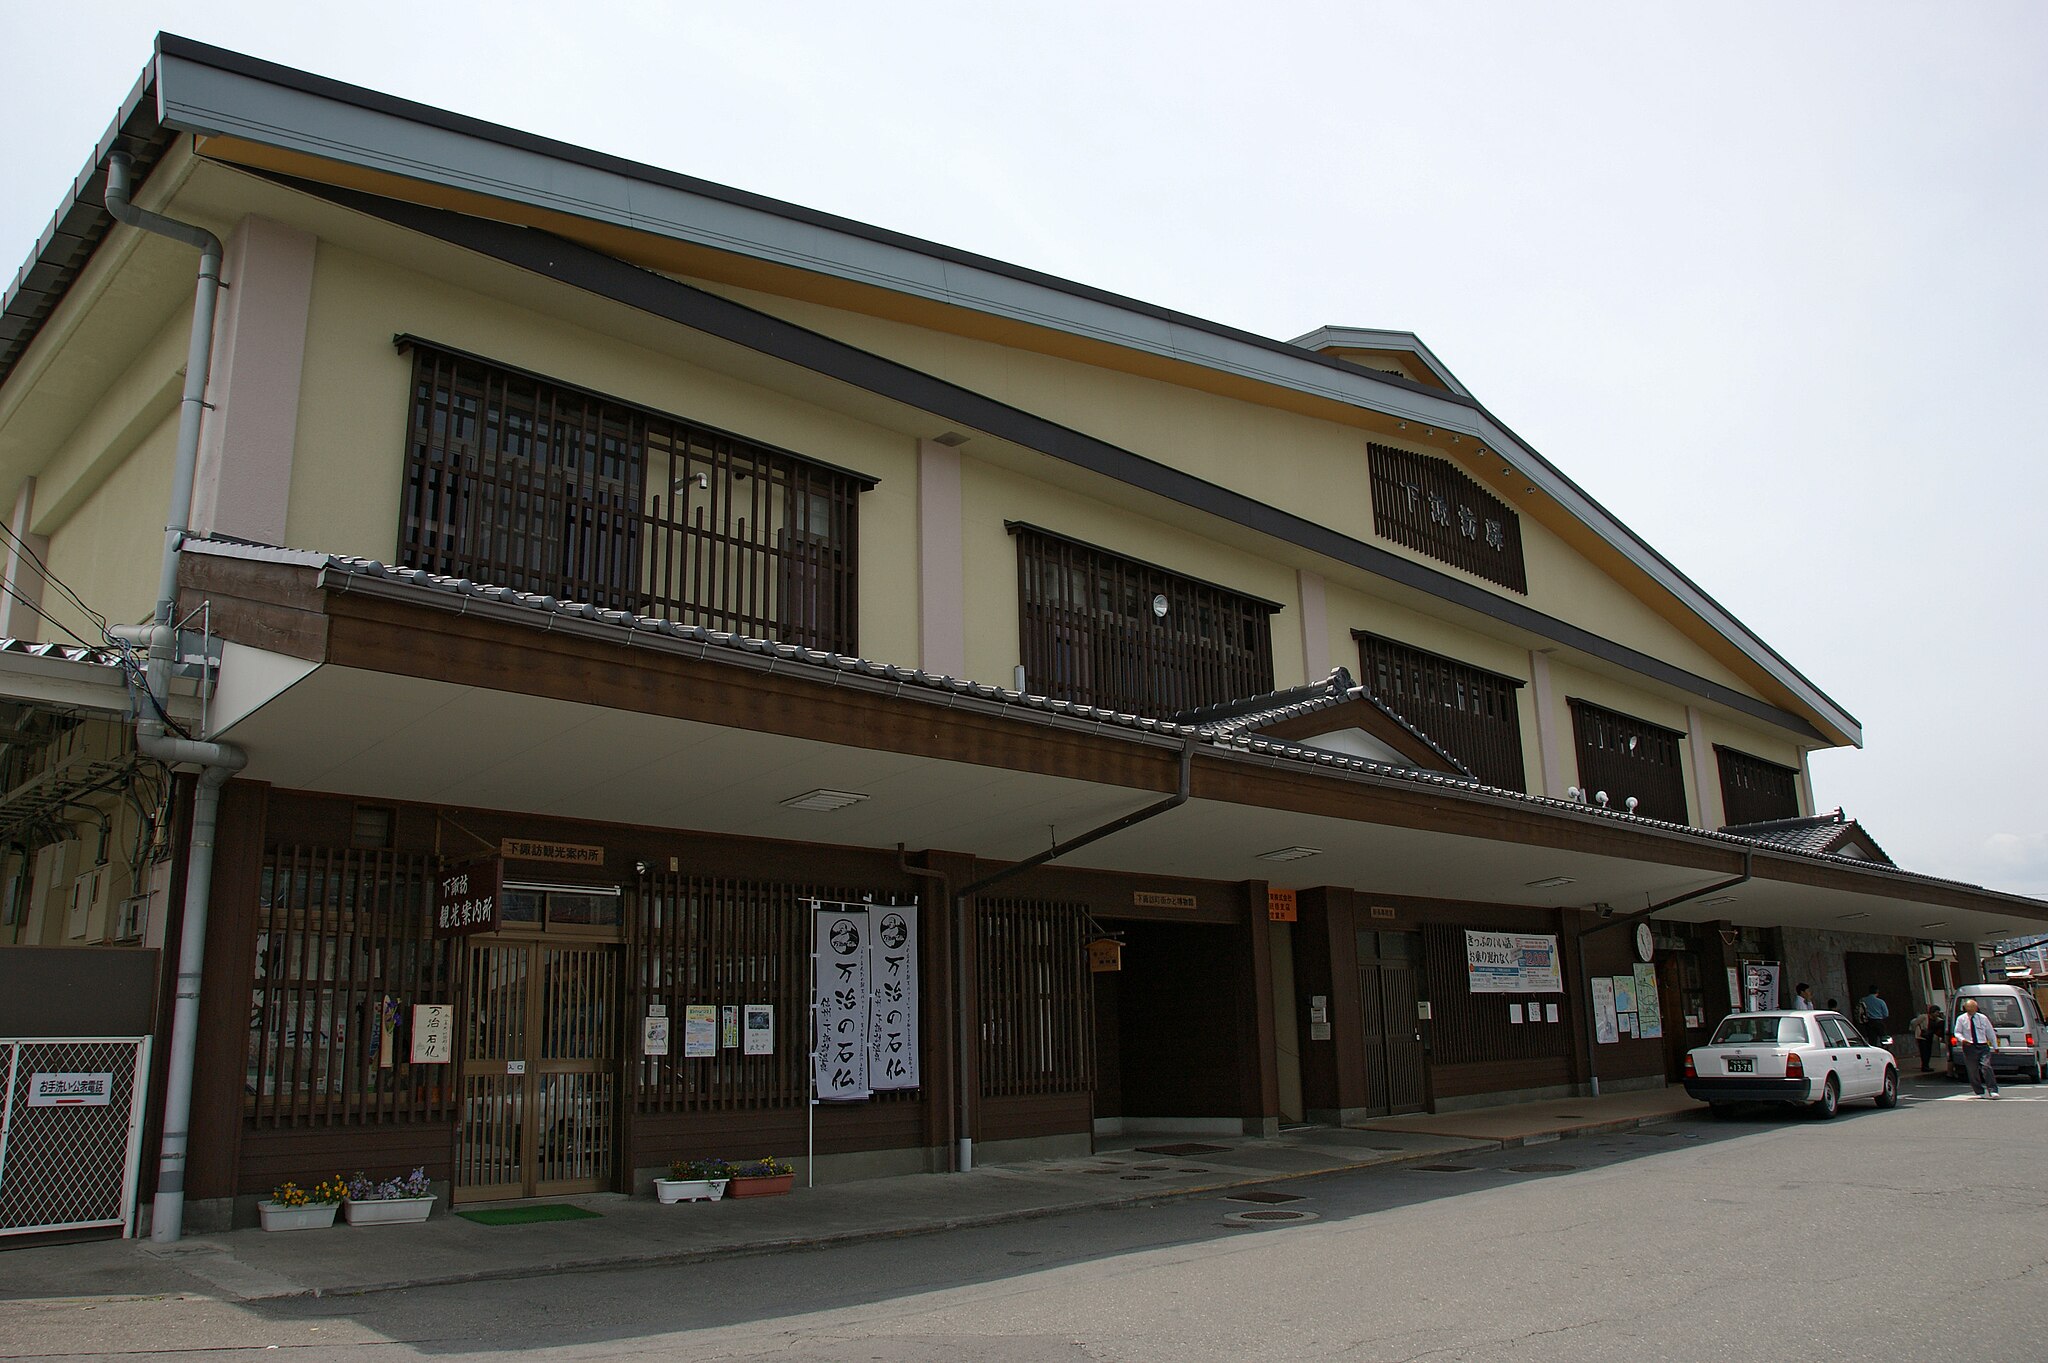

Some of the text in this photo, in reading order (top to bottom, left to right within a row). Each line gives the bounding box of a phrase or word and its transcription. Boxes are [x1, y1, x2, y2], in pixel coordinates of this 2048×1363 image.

[442, 874, 469, 898] 下諏訪
[508, 842, 599, 861] 下諏訪観光案内所
[832, 962, 858, 1092] 万治の石仏
[883, 956, 907, 1080] 万治の石仏
